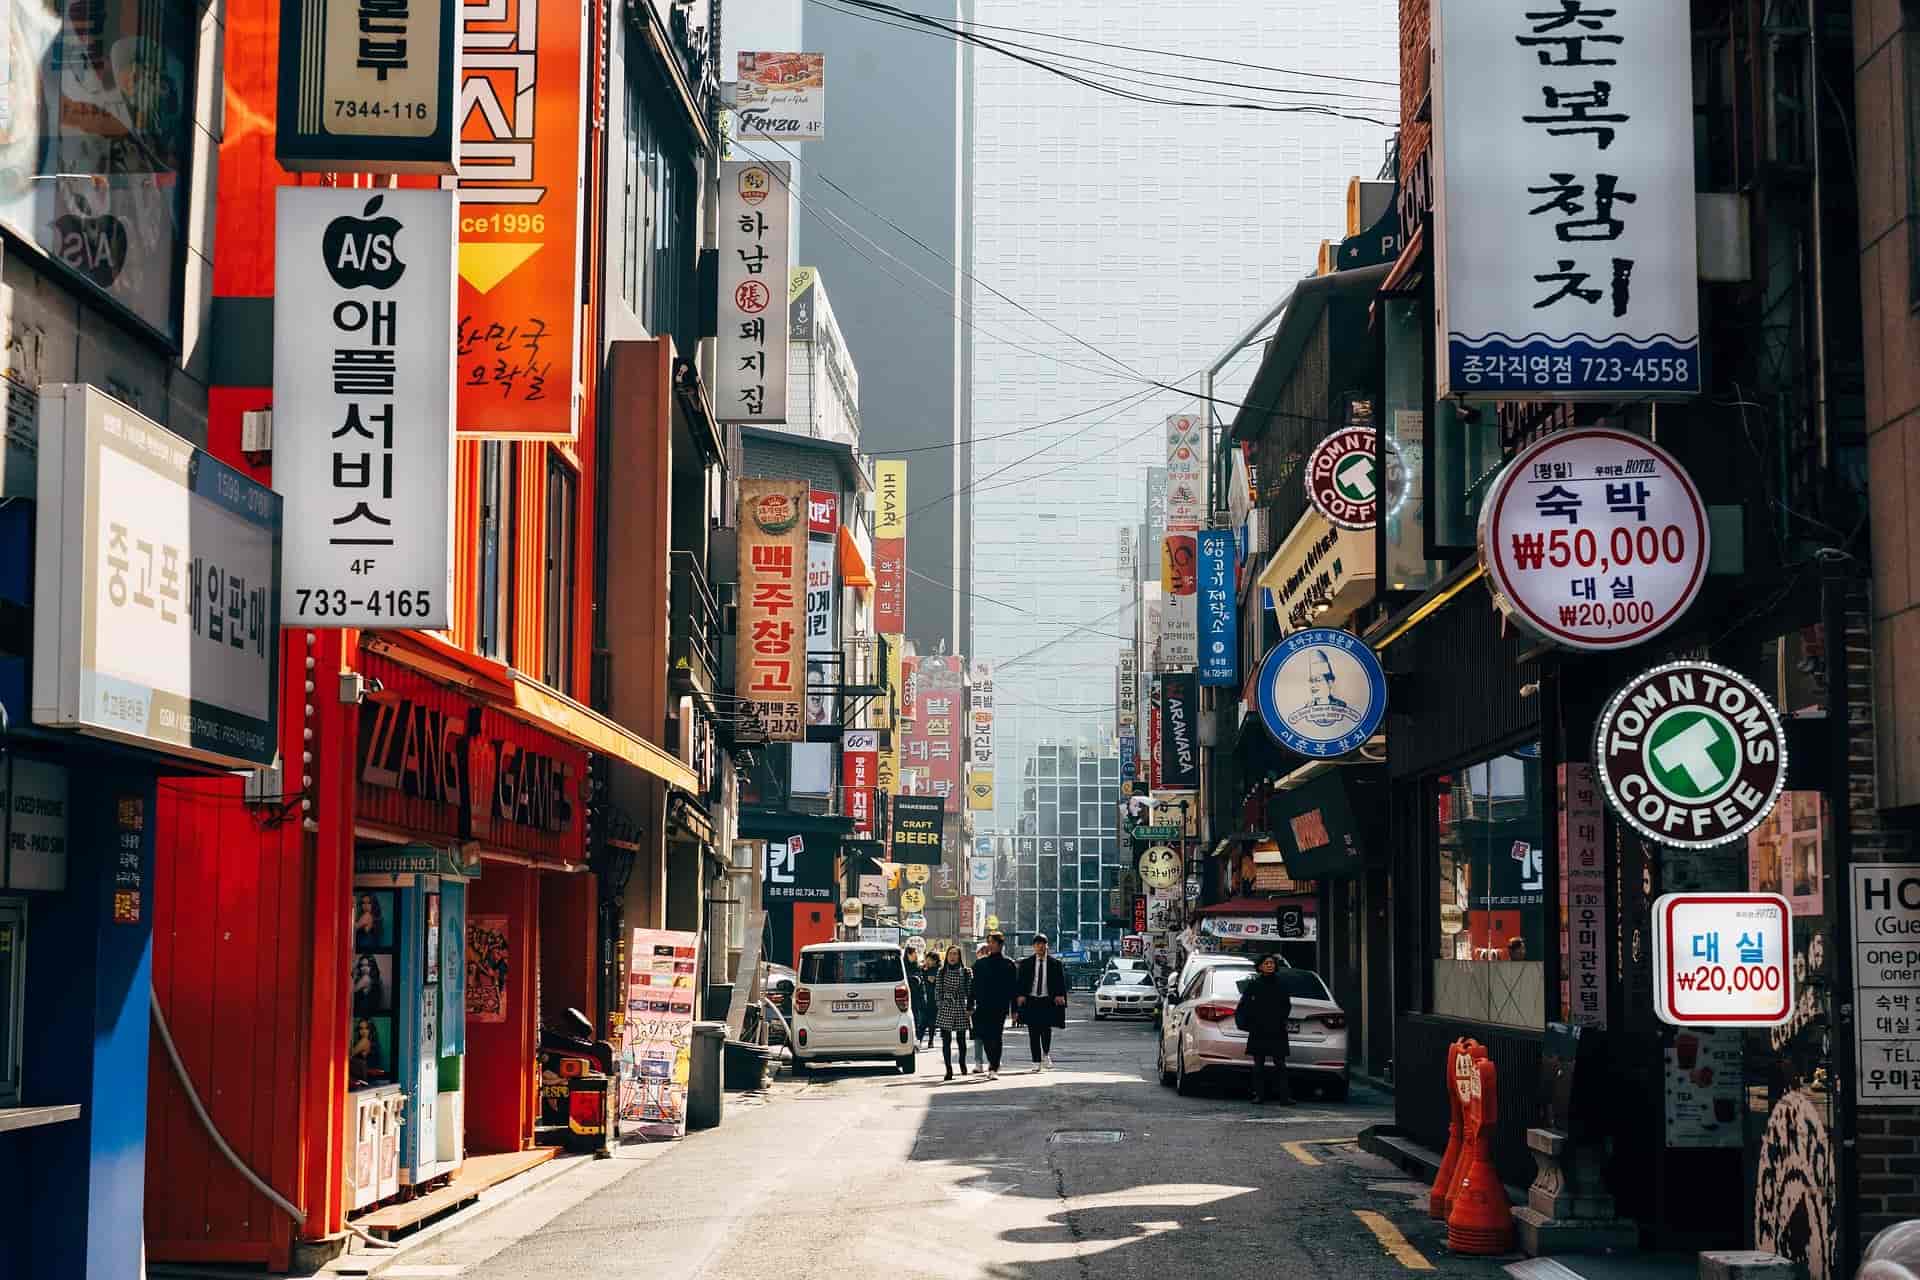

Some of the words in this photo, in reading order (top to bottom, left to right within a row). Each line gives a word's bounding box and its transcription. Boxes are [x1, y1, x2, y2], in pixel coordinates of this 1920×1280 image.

[334, 101, 427, 118] 7344-116
[740, 109, 800, 132] Forza
[806, 121, 821, 132] 4F
[337, 233, 392, 270] A/S
[1461, 355, 1573, 384] 종각직영점
[1581, 354, 1690, 383] 723-4558
[330, 301, 397, 546] 애플서비스
[1534, 461, 1573, 480] [평일]
[1624, 458, 1656, 474] HOTEL
[884, 473, 896, 526] HIKARI
[1512, 525, 1686, 575] ₩50,000
[350, 560, 376, 576] 4F
[296, 588, 431, 618] 733-4165
[1559, 601, 1654, 629] ₩20,000
[1611, 684, 1668, 757] TOM
[1668, 673, 1696, 701] N
[1700, 673, 1776, 765] TOMS
[1618, 774, 1764, 837] COFFEE
[894, 832, 939, 847] BEER
[902, 819, 933, 832] CRAFT
[1676, 966, 1781, 995] ₩20,000
[1875, 995, 1909, 1010] 숙박
[1876, 1017, 1909, 1033] 대실
